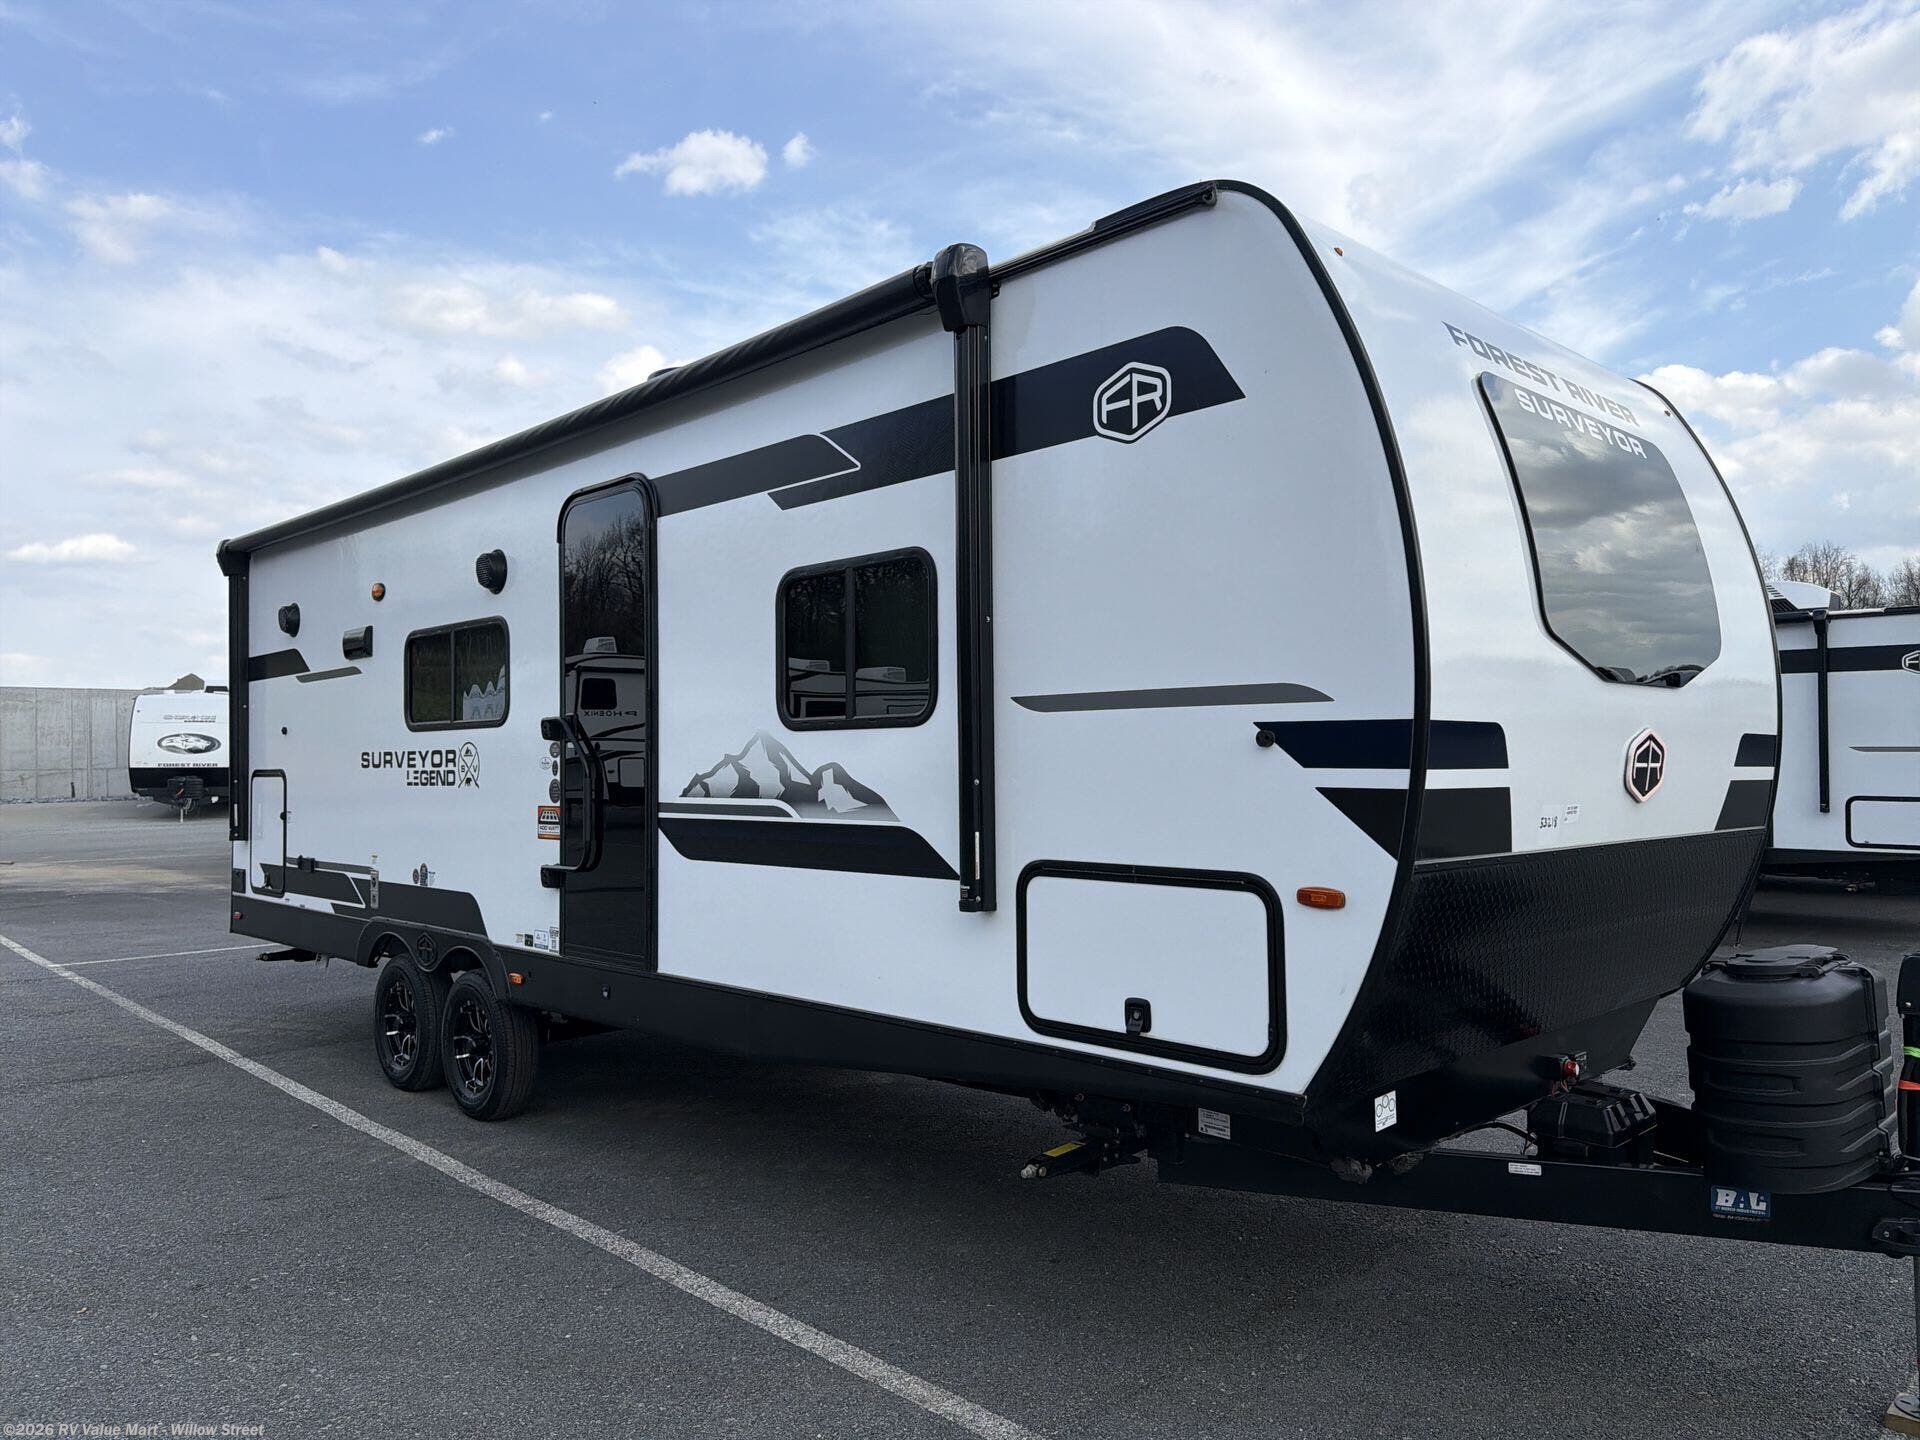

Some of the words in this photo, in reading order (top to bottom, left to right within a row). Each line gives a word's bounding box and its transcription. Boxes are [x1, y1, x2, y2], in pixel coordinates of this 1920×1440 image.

[1441, 320, 1561, 392] FOREST
[1559, 377, 1641, 427] RIVER
[1514, 388, 1648, 459] SURVEYOR
[361, 750, 457, 769] SURVEYOR
[406, 769, 456, 787] LEGEND
